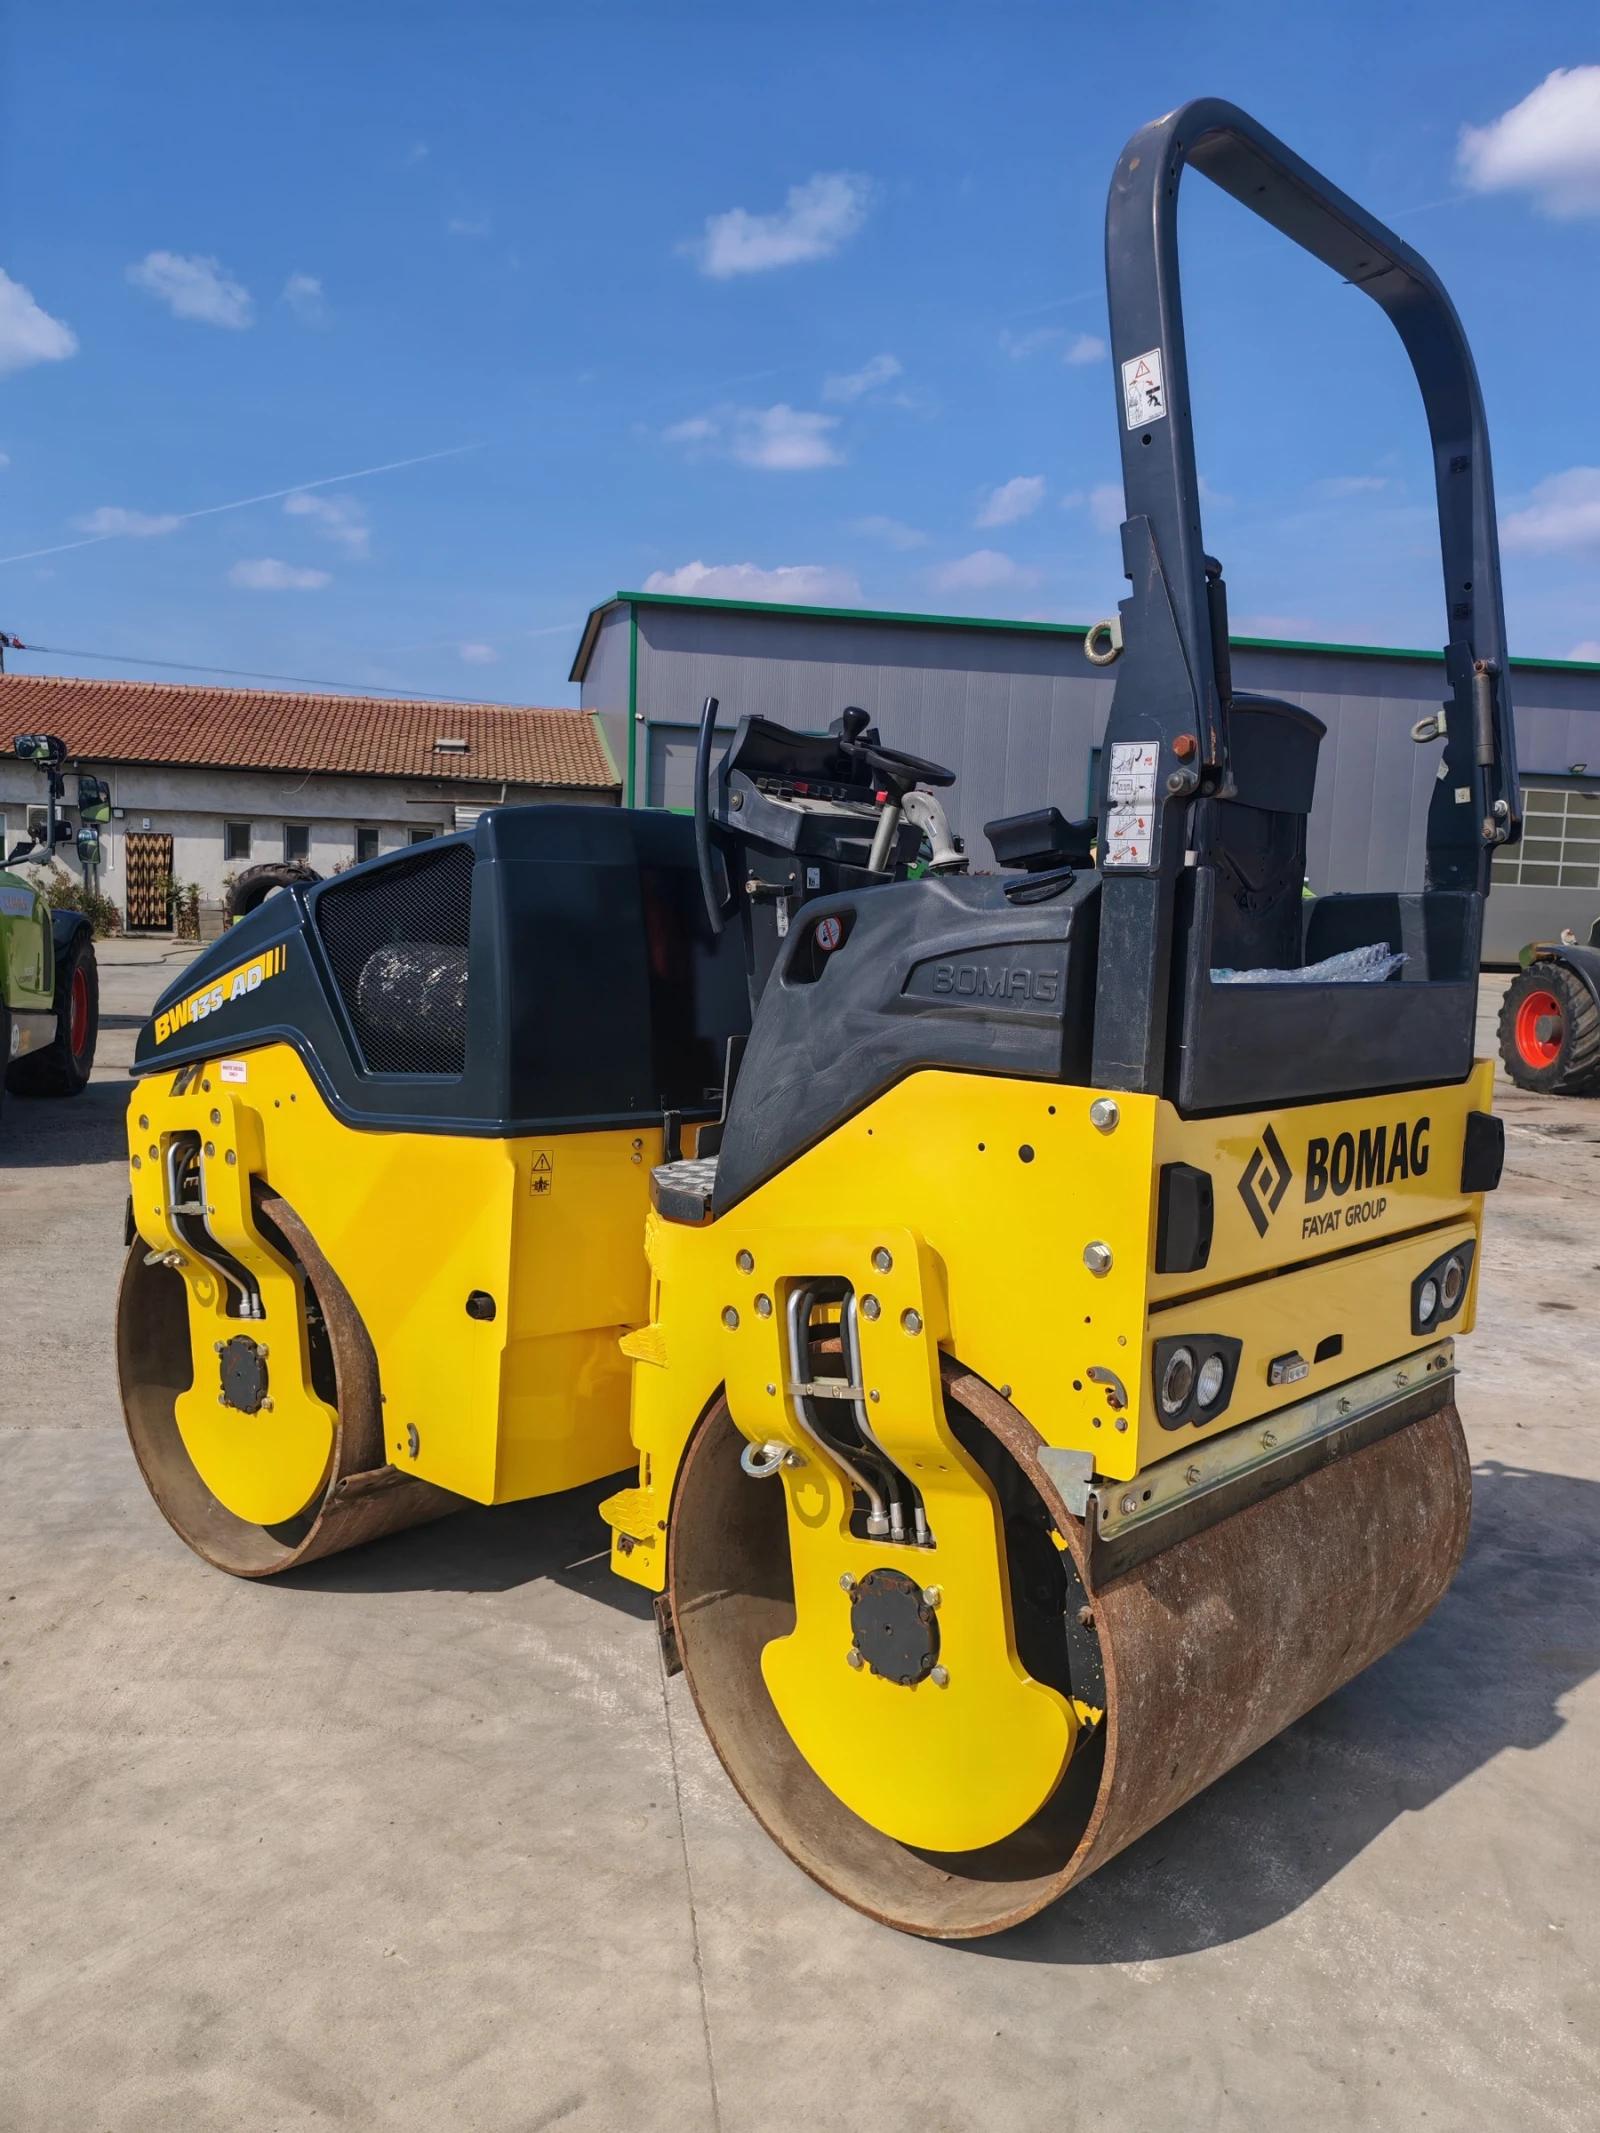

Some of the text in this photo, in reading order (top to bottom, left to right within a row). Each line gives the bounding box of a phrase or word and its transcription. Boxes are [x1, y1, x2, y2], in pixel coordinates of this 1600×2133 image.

[230, 965, 262, 1001] AD
[933, 964, 1058, 1001] BOMAG
[1305, 1117, 1430, 1204] BOMAG
[1302, 1197, 1387, 1239] FAYAT GROUP
